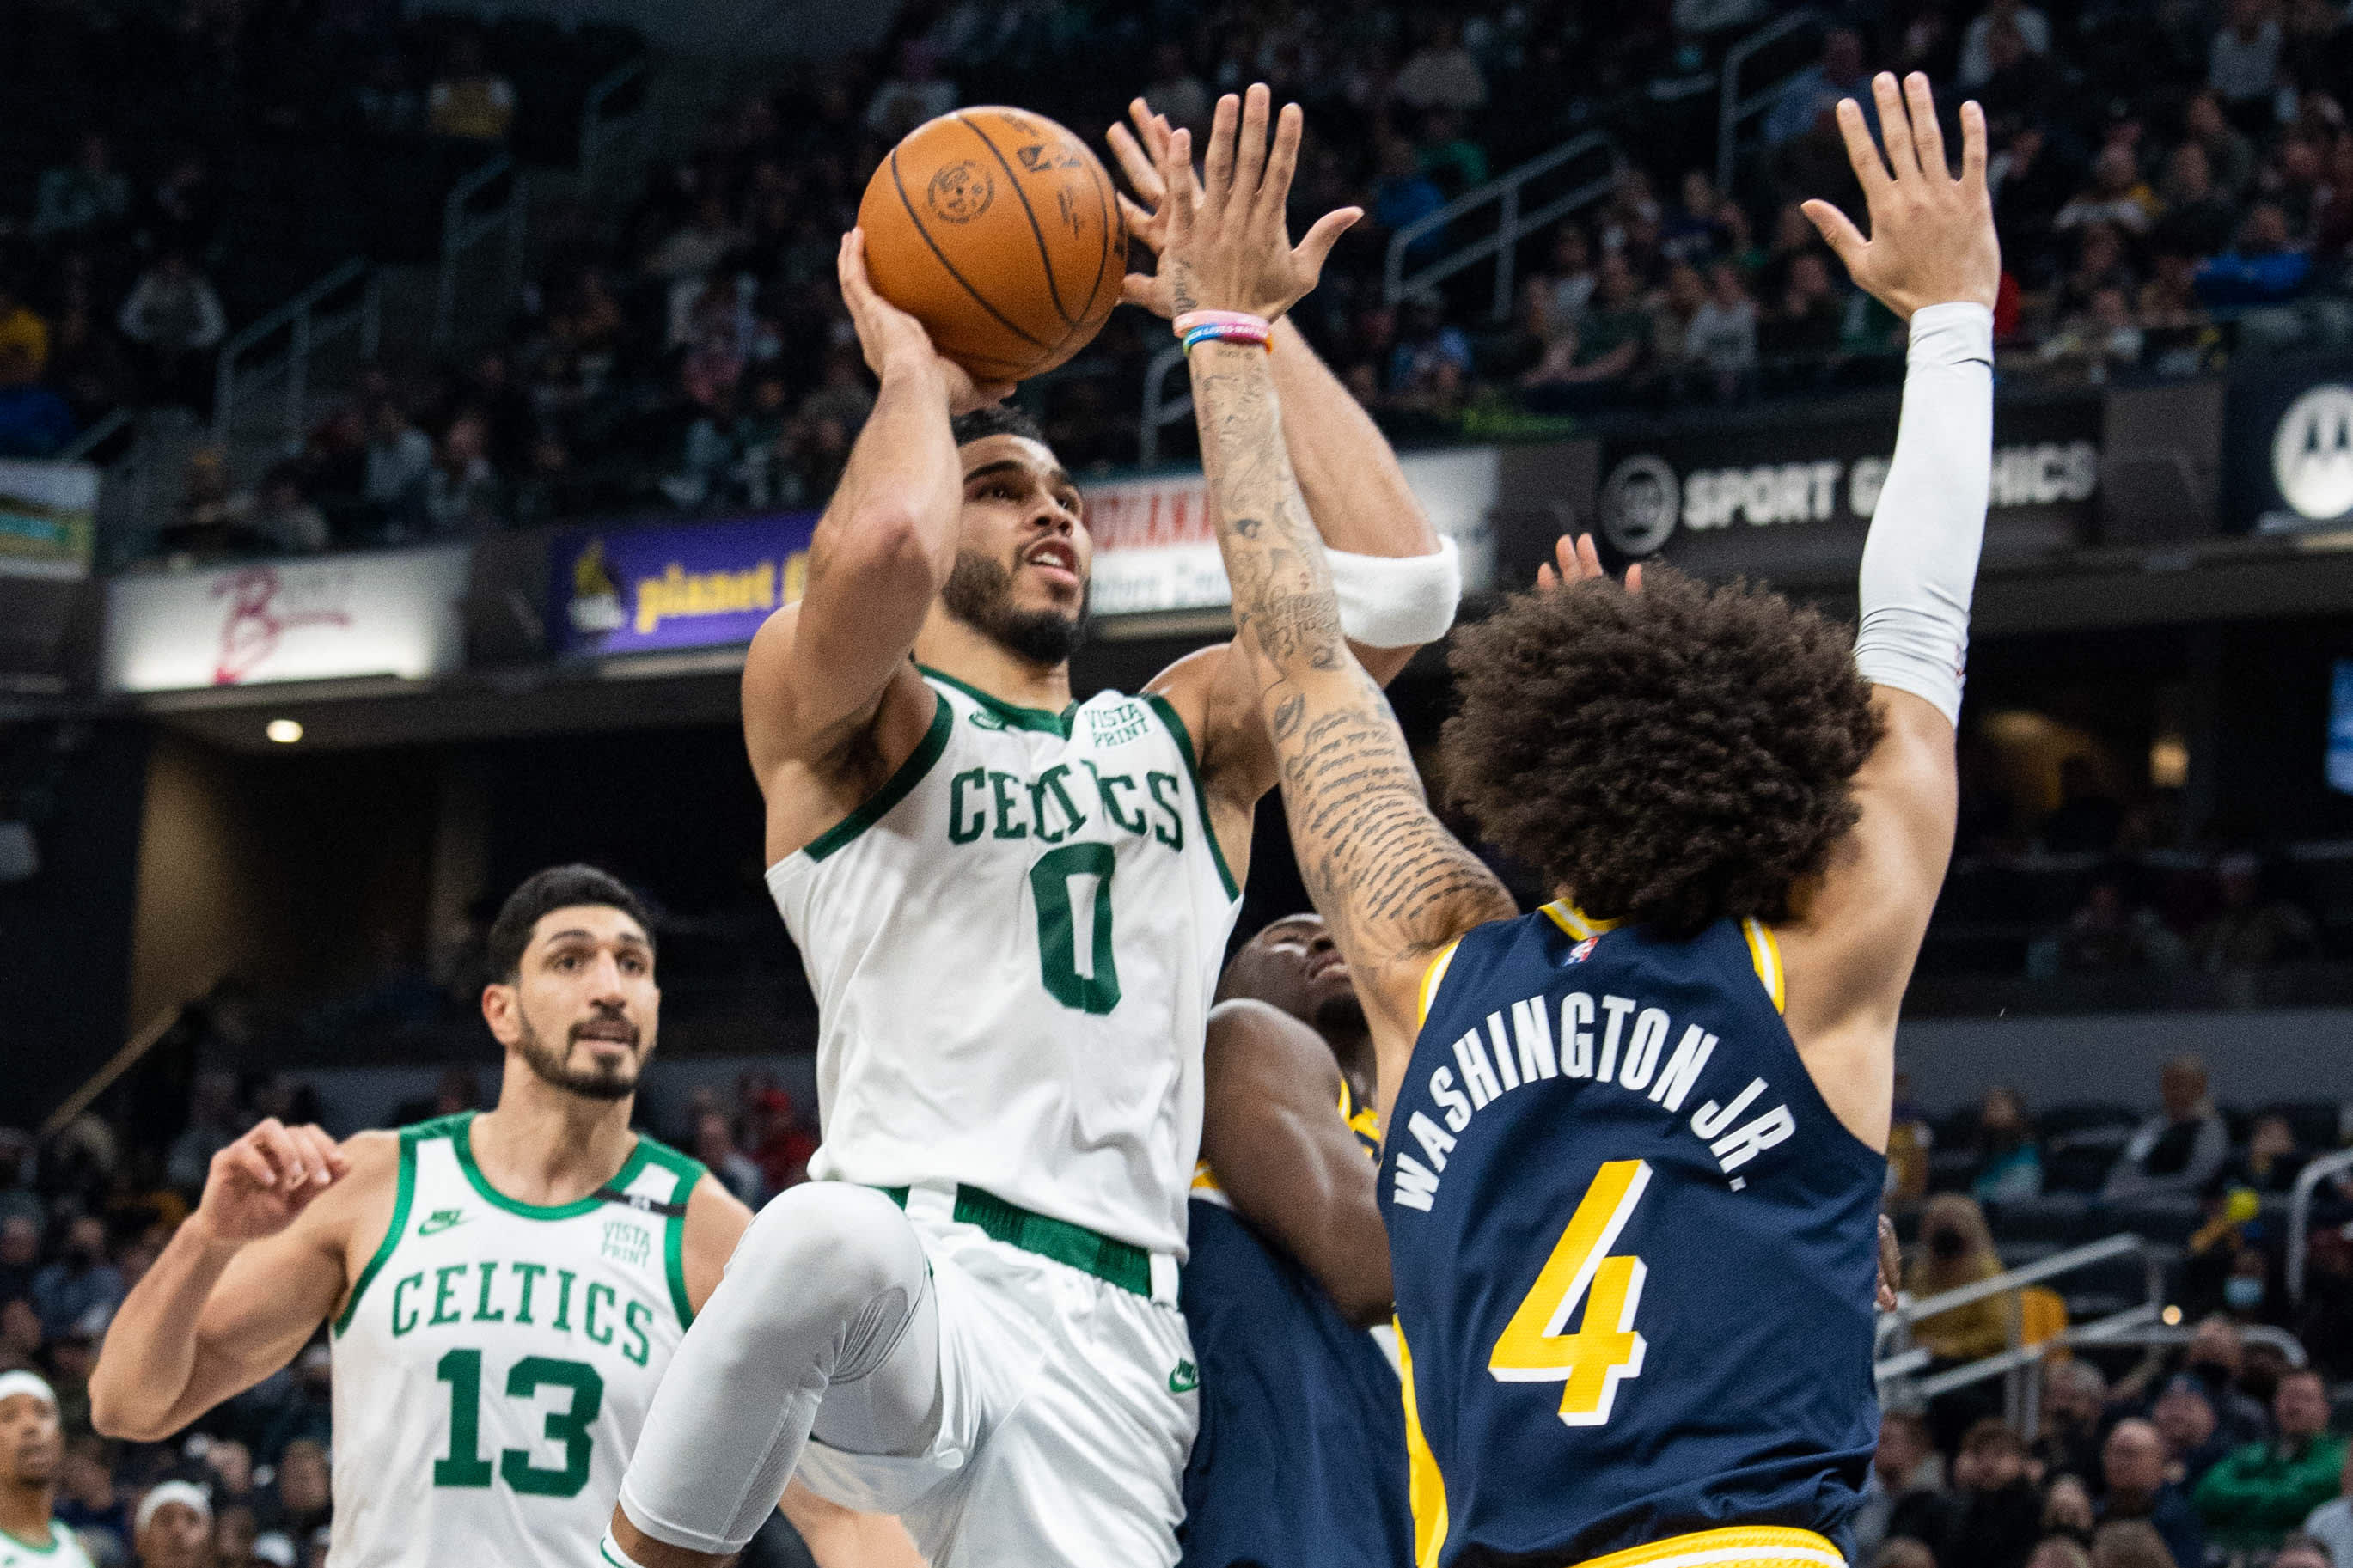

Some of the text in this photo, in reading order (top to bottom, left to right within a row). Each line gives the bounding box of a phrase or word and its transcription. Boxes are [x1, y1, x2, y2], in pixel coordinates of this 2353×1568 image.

[1683, 459, 1844, 531] SPORT
[1849, 439, 2097, 517] GHICS
[634, 563, 773, 634] planet
[1084, 703, 1146, 729] VISTA
[1092, 717, 1148, 747] PRINT
[1029, 841, 1121, 1016] 0
[1392, 991, 1796, 1213] WASHINGTON JR.
[603, 1221, 651, 1248] VISTA
[392, 1260, 654, 1368] CELTICS
[1488, 1158, 1653, 1428] 4
[433, 1347, 605, 1498] 13
